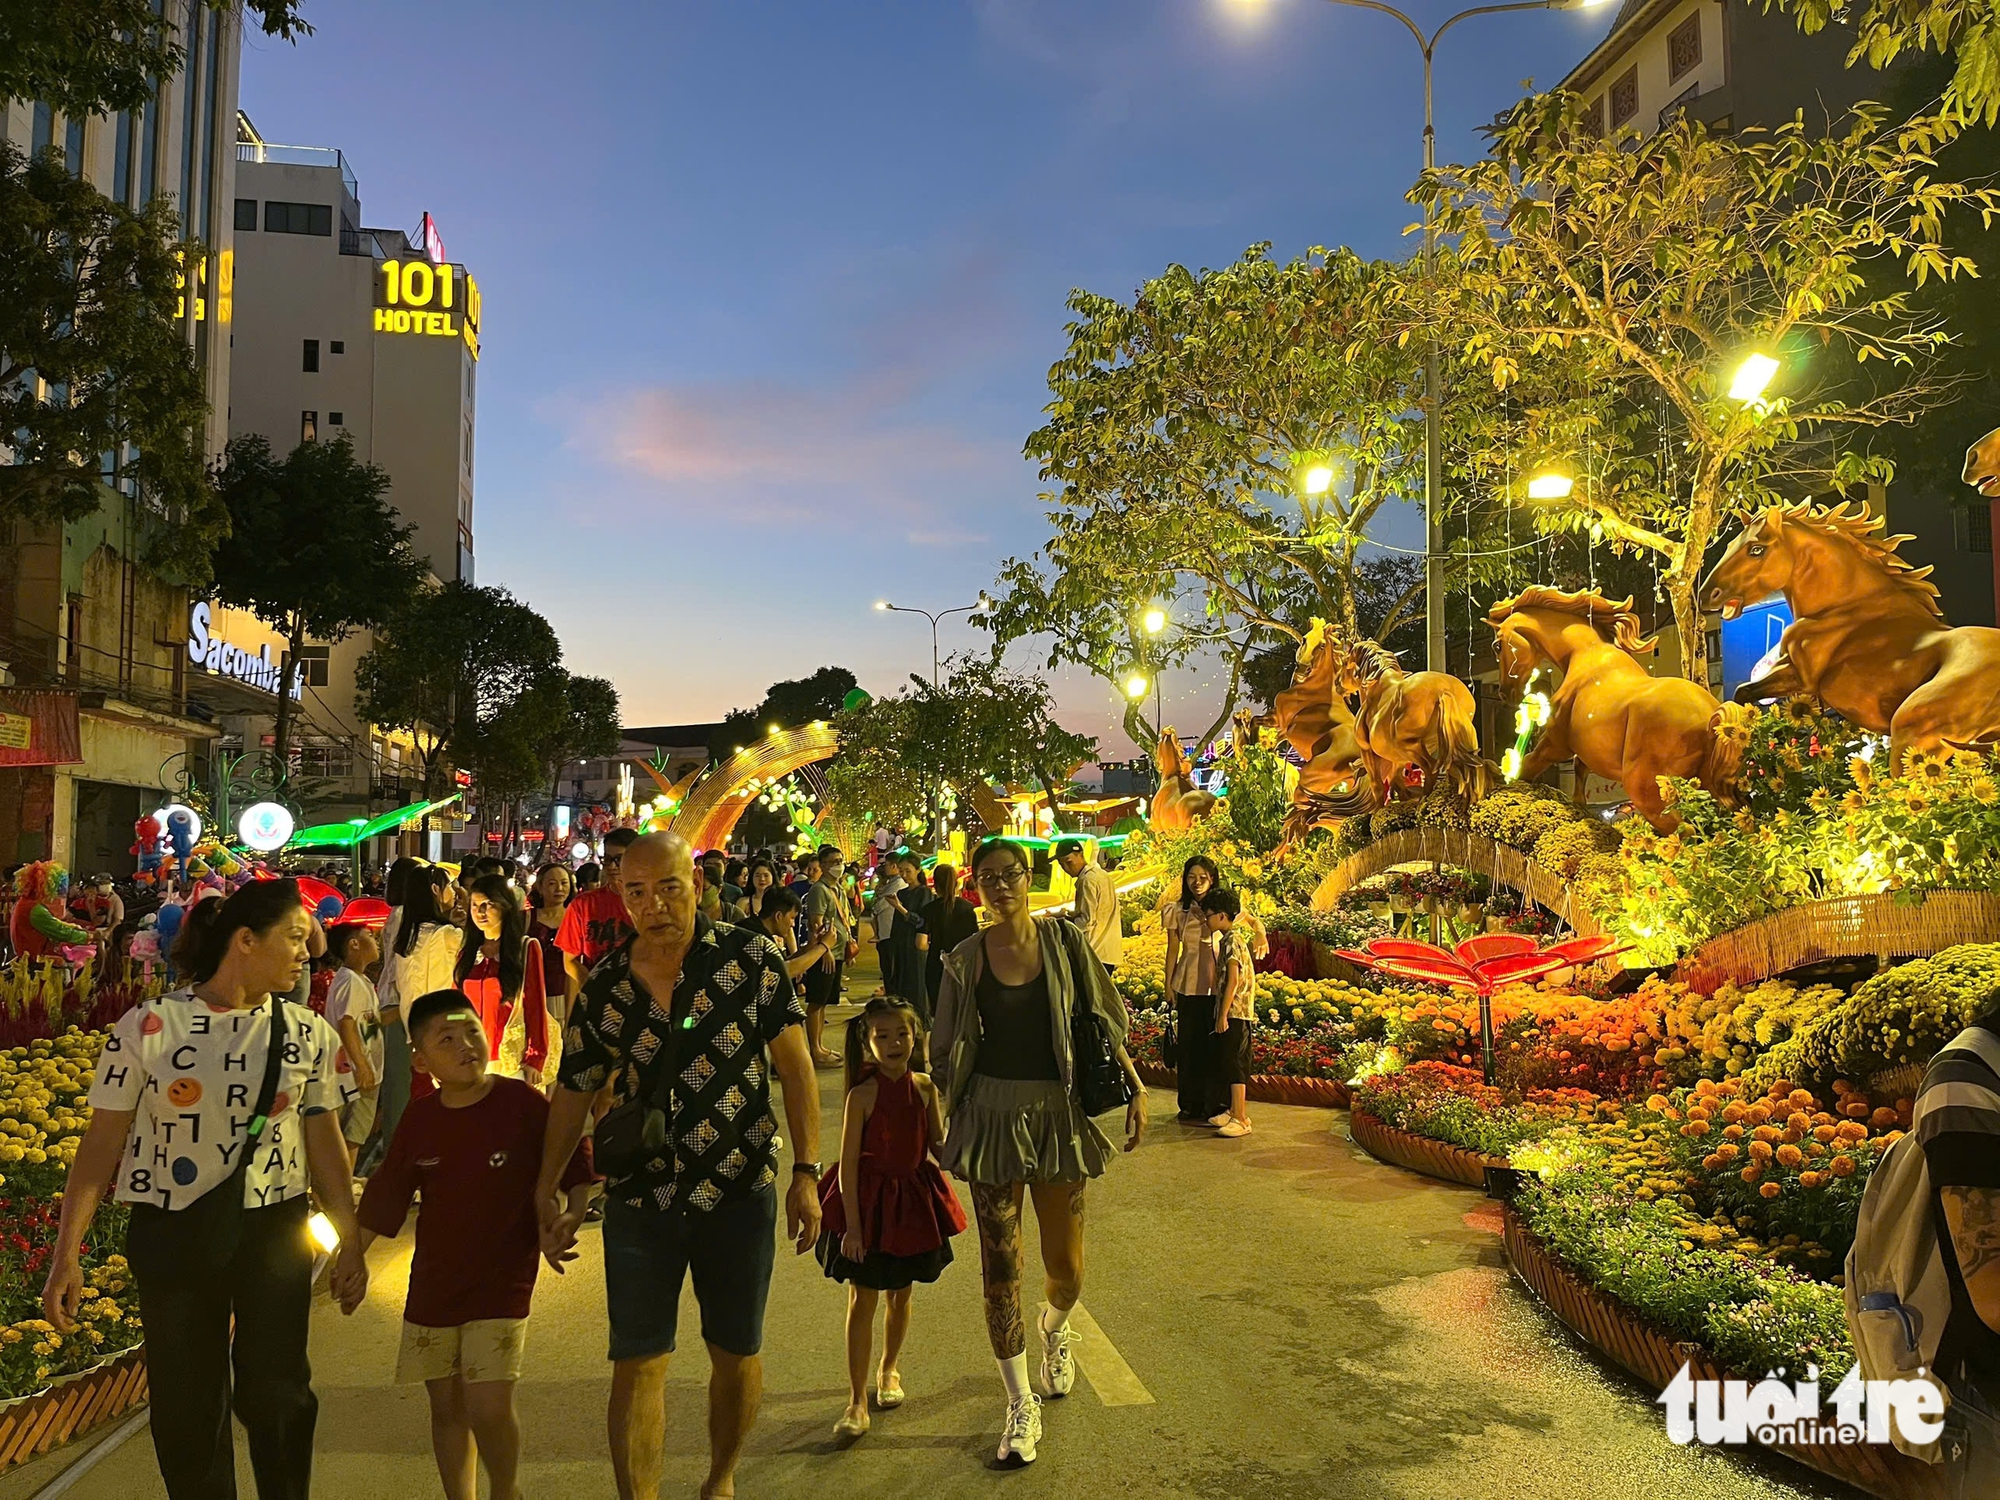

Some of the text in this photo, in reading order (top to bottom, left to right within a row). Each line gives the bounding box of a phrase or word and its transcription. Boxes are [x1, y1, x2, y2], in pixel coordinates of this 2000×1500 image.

[382, 260, 453, 308] 101
[467, 274, 481, 334] 101
[374, 308, 459, 336] HOTEL
[189, 601, 305, 701] Sacombak
[171, 1045, 197, 1070] C
[225, 1053, 246, 1071] H
[283, 1042, 300, 1064] 8
[103, 1064, 128, 1087] H
[227, 1084, 248, 1107] R
[161, 1122, 177, 1143] T
[271, 1122, 282, 1143] 8
[153, 1144, 168, 1168] H
[216, 1142, 240, 1165] Y
[263, 1147, 285, 1174] A
[129, 1169, 151, 1193] 8
[254, 1184, 271, 1207] Y
